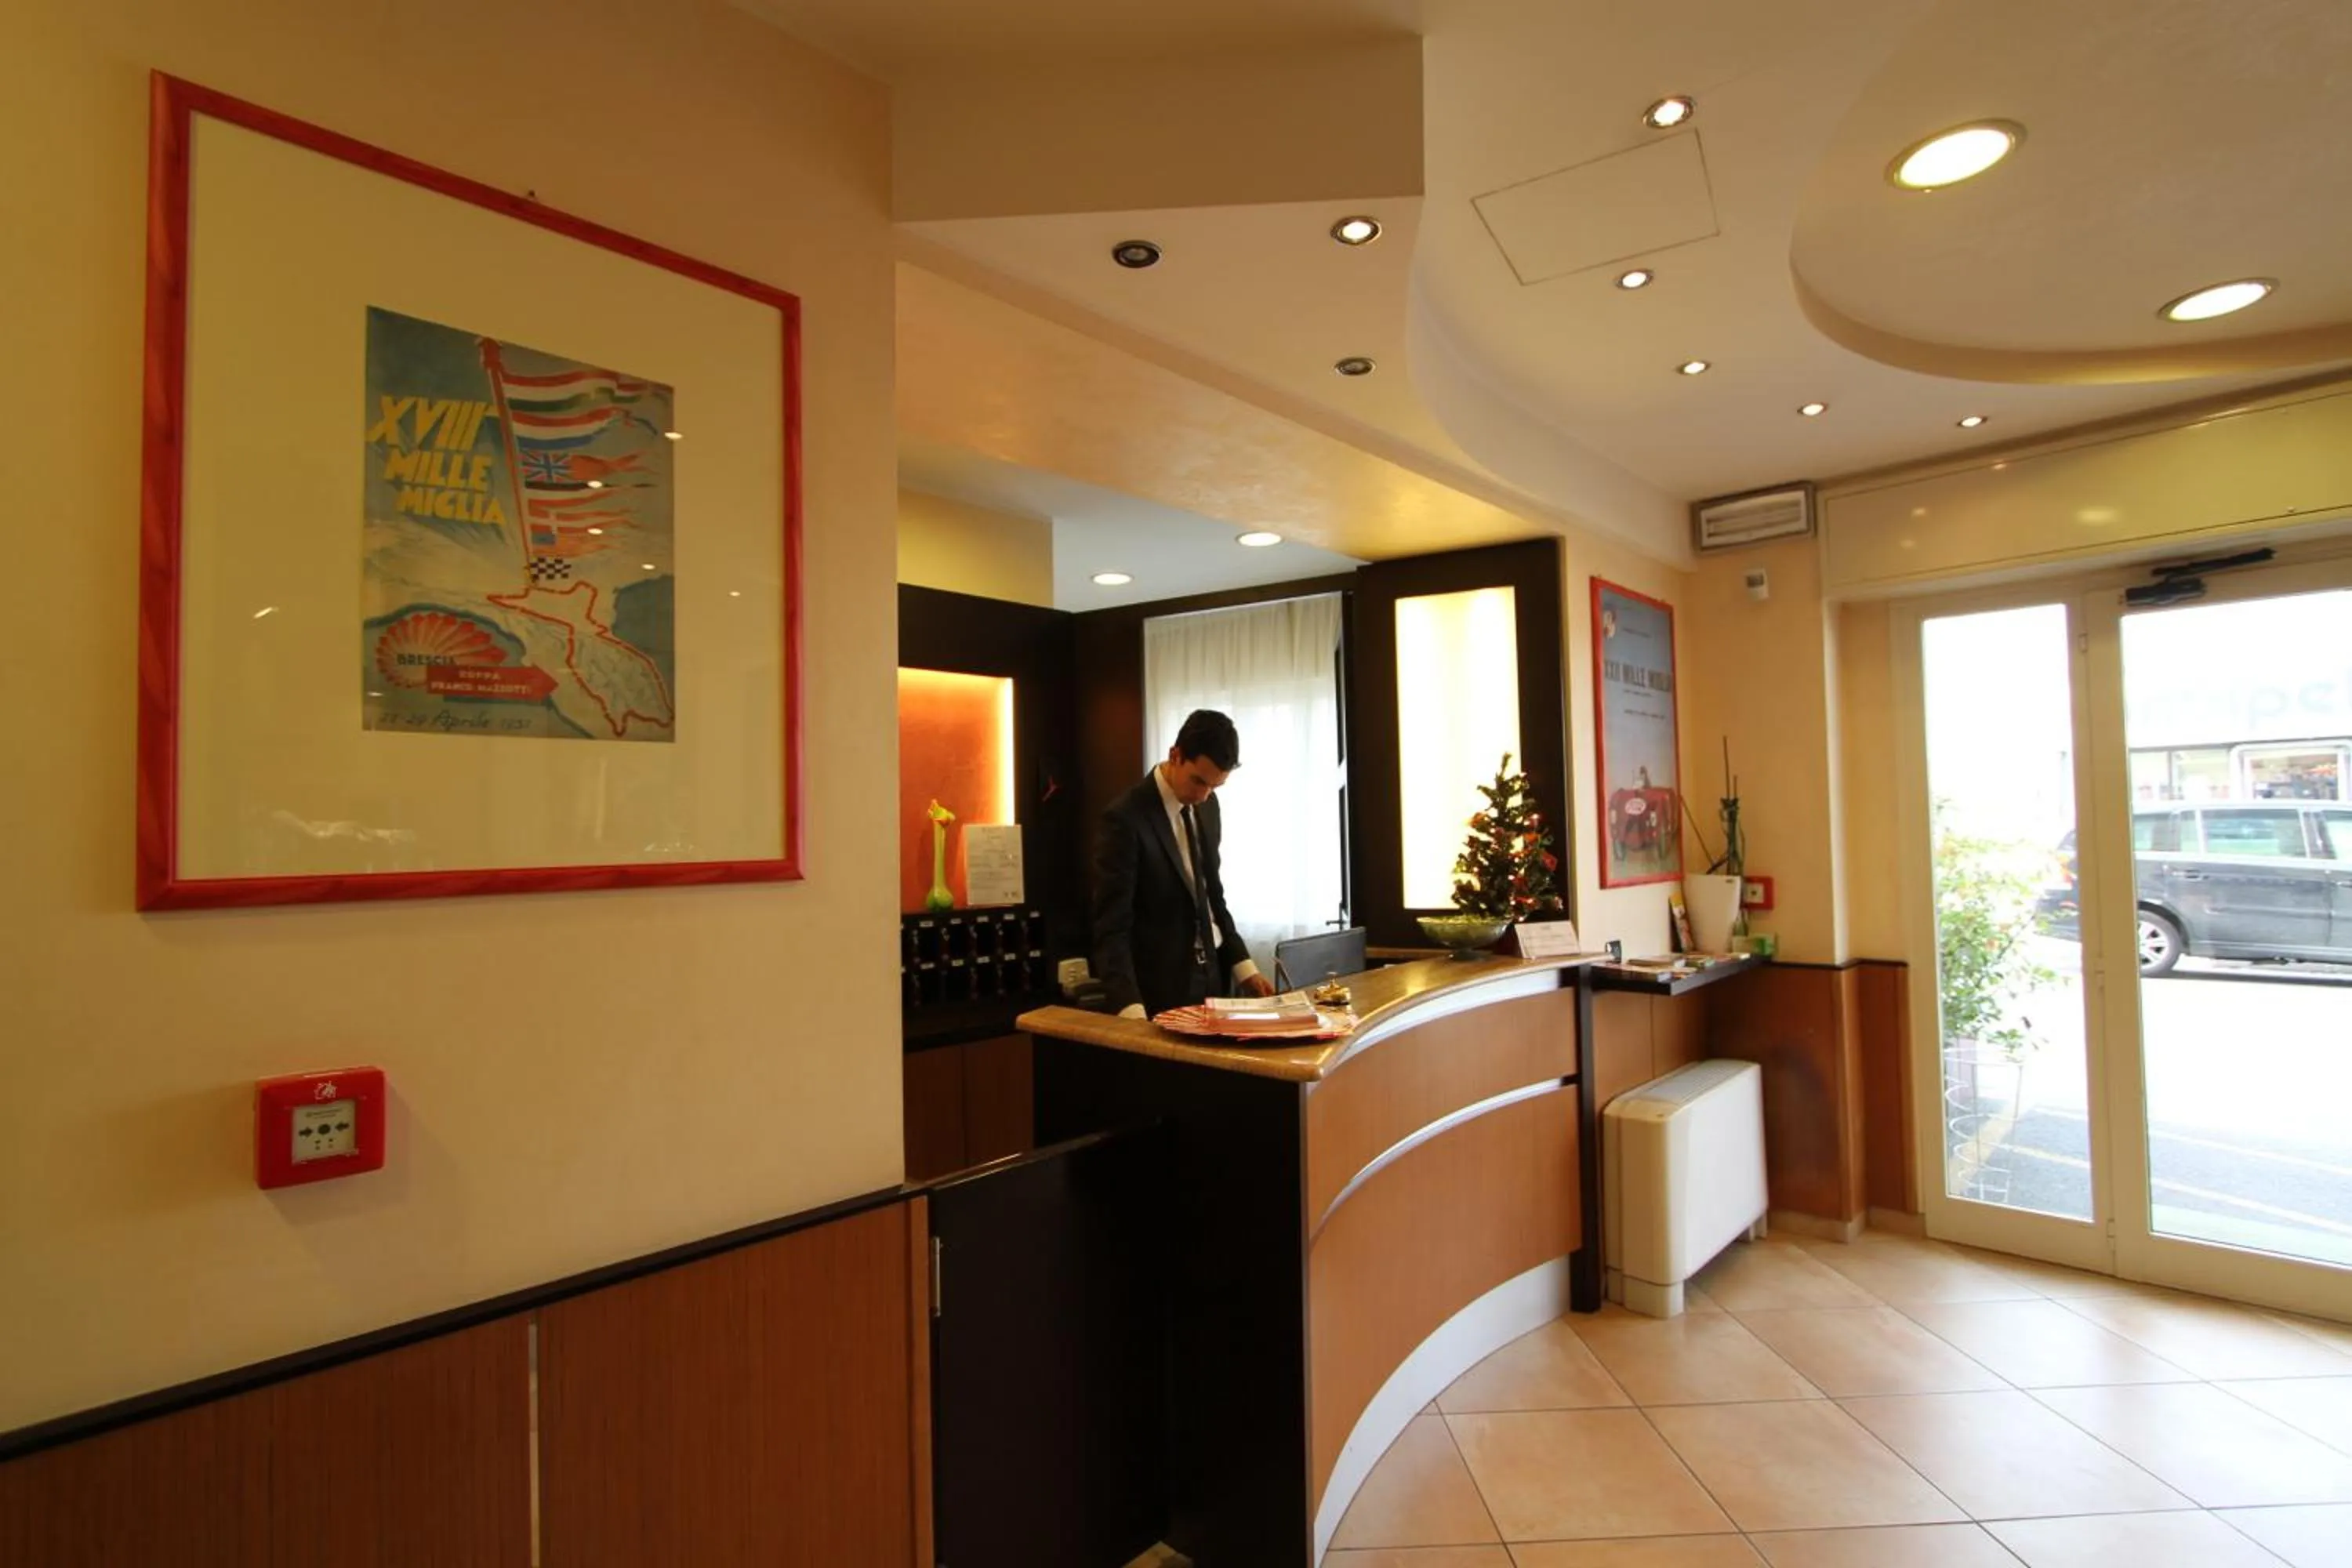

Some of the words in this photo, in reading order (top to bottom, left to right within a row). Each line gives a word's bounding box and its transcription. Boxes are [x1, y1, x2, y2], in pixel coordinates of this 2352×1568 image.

[365, 395, 489, 451] XVIII
[384, 448, 492, 492] MILLE
[396, 485, 506, 525] MIGLIA
[397, 652, 456, 666] BRESCIA
